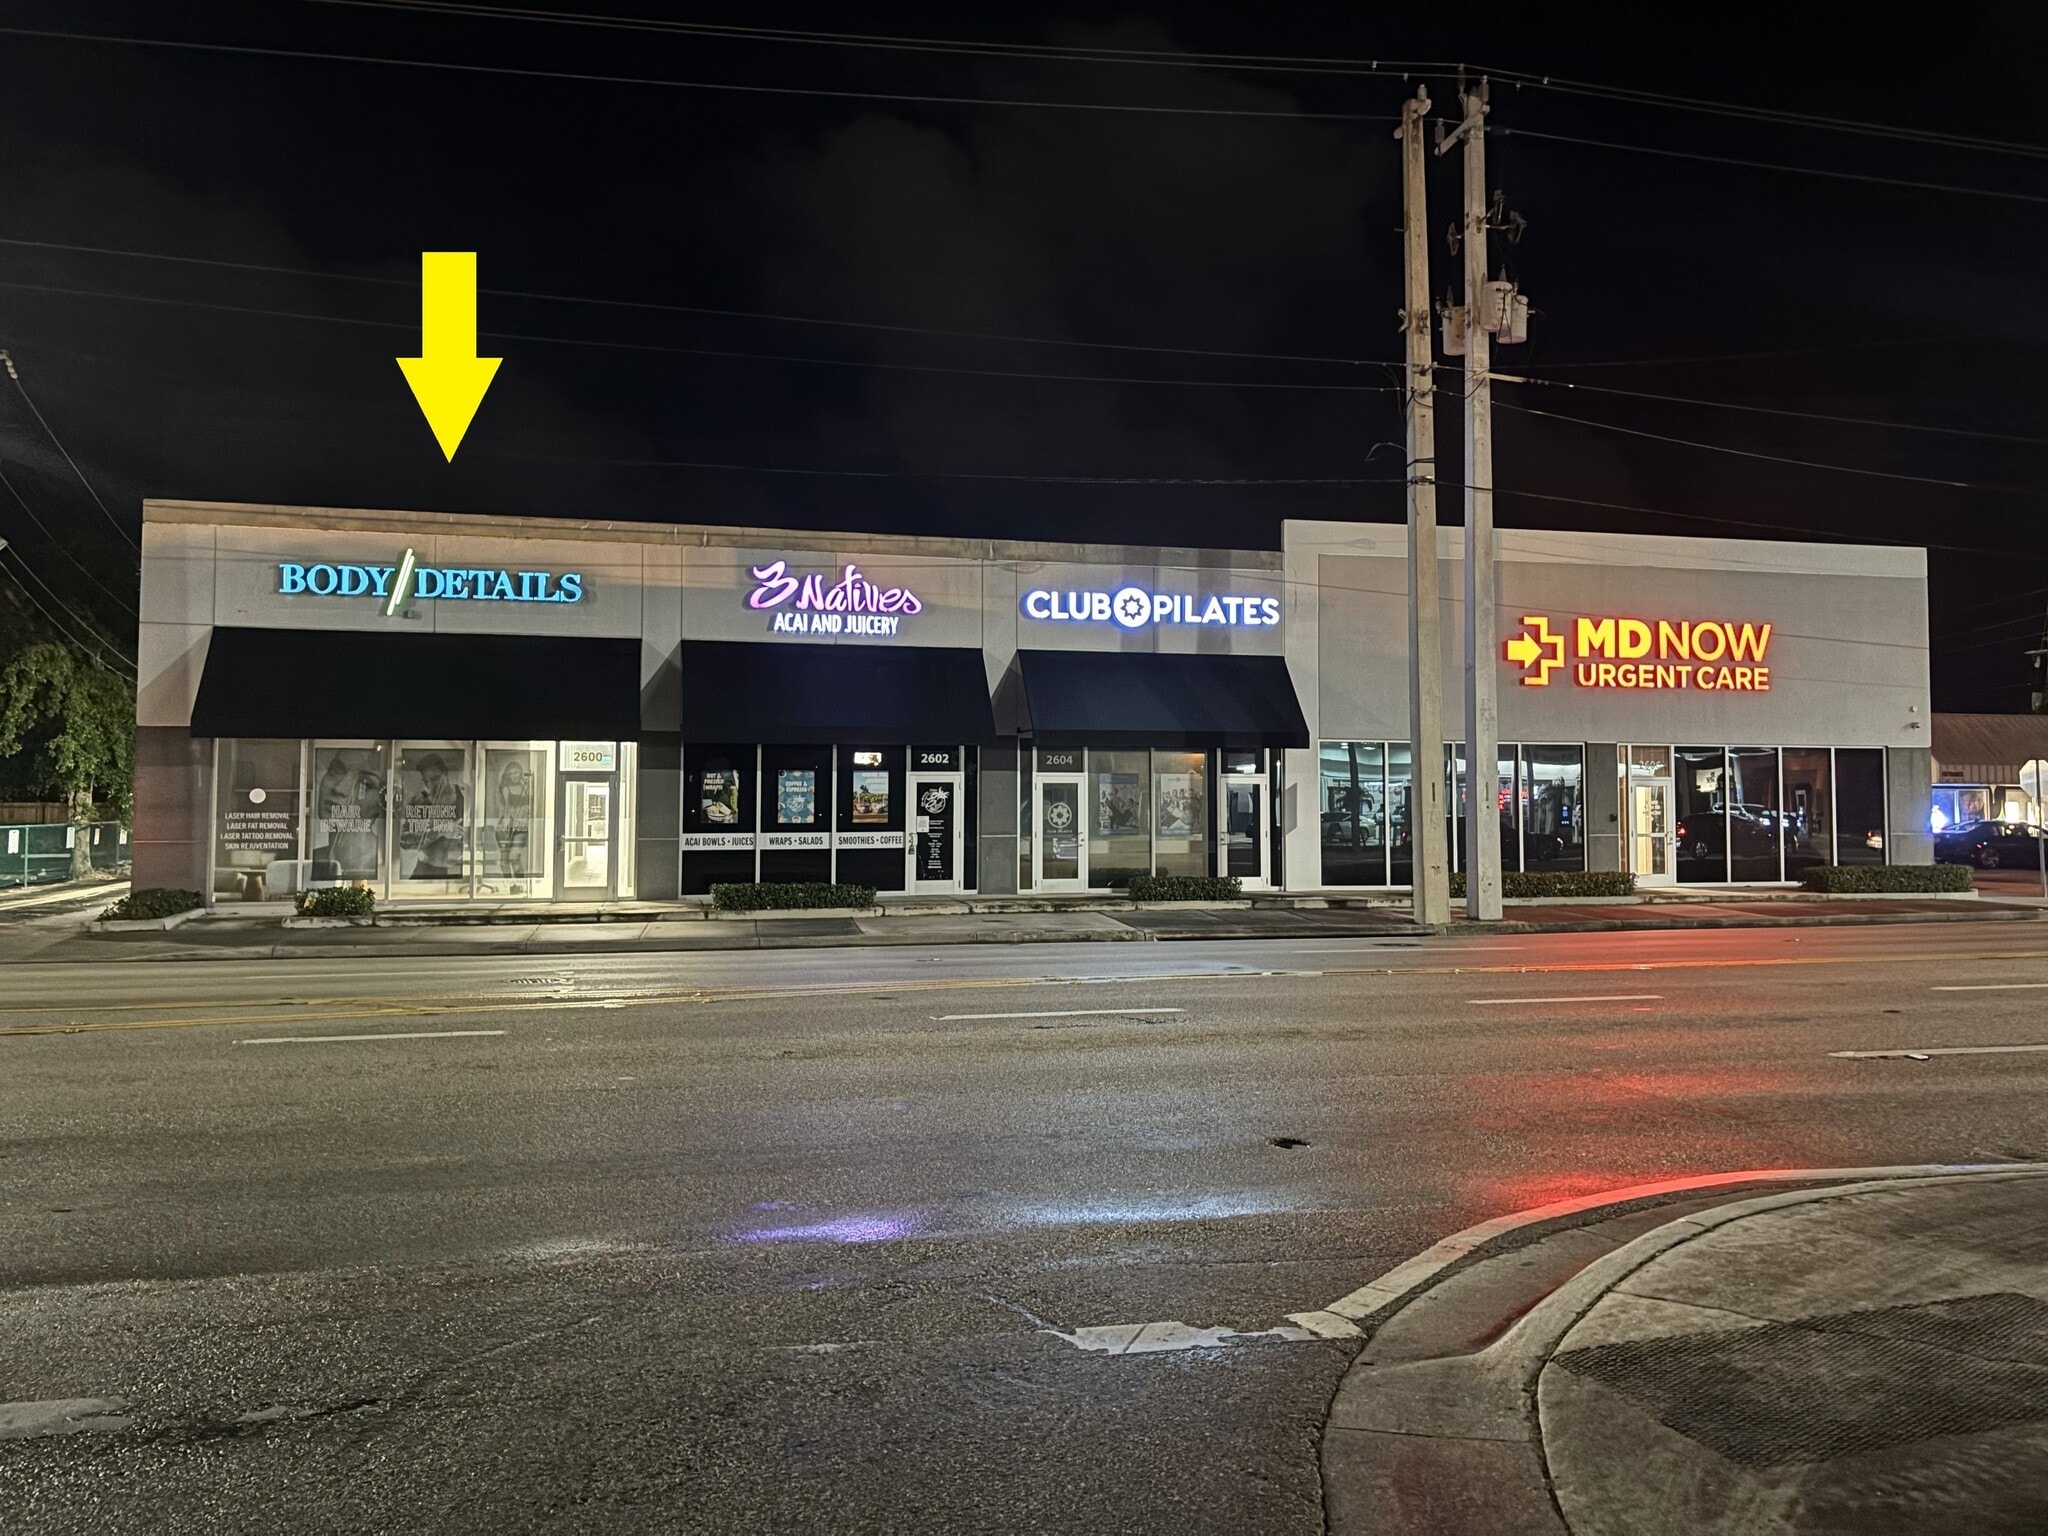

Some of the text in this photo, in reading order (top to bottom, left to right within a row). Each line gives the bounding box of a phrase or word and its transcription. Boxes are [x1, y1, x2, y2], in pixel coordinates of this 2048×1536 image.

[279, 563, 583, 603] BODY DETAILS
[750, 560, 922, 615] 3 Natives
[1026, 590, 1280, 625] CLUB PILATES
[773, 612, 899, 634] ACAI AND JUICERY
[1577, 617, 1771, 662] MD NOW
[1577, 663, 1770, 691] URGENT CARE
[573, 751, 603, 762] 2600
[921, 753, 950, 764] 2602
[1046, 755, 1074, 765] 2604
[224, 812, 290, 820] LASER HAIR REMOVAL
[226, 822, 288, 830] LASER FAT REMOVAL
[220, 832, 294, 840] LASER TATTOO REMOVAL
[702, 837, 726, 846] BOWLS
[731, 836, 754, 846] JUICES
[769, 836, 824, 846] WRAPS SALADS
[838, 835, 903, 845] SMOOTHIES COFFEE
[224, 842, 240, 850] SKIN
